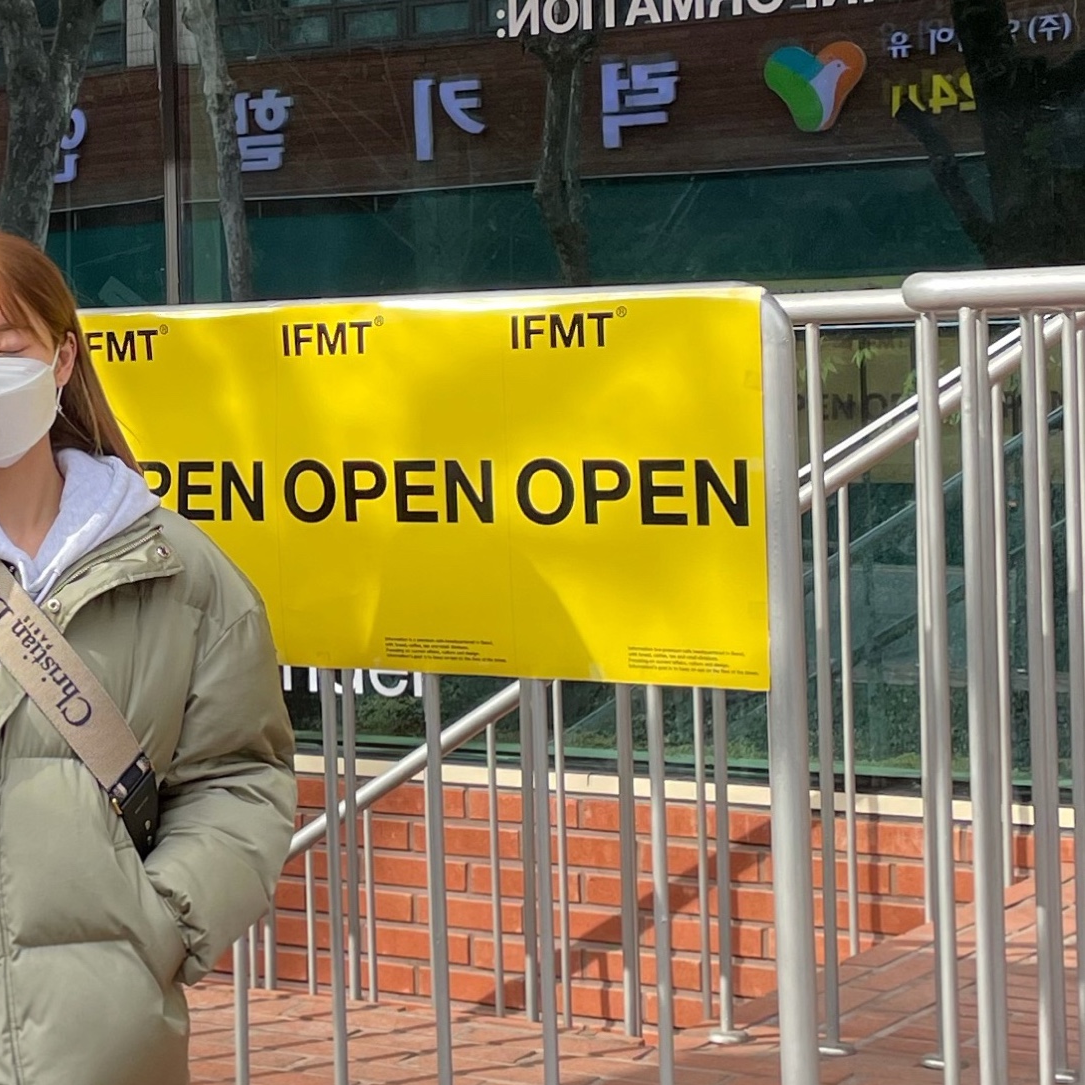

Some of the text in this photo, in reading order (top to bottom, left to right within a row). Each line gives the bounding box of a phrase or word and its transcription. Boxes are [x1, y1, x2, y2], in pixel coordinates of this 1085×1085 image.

[137, 460, 265, 522] PEN
[283, 459, 496, 524] OPEN
[516, 458, 750, 527] OPEN
[12, 617, 92, 728] Christian
